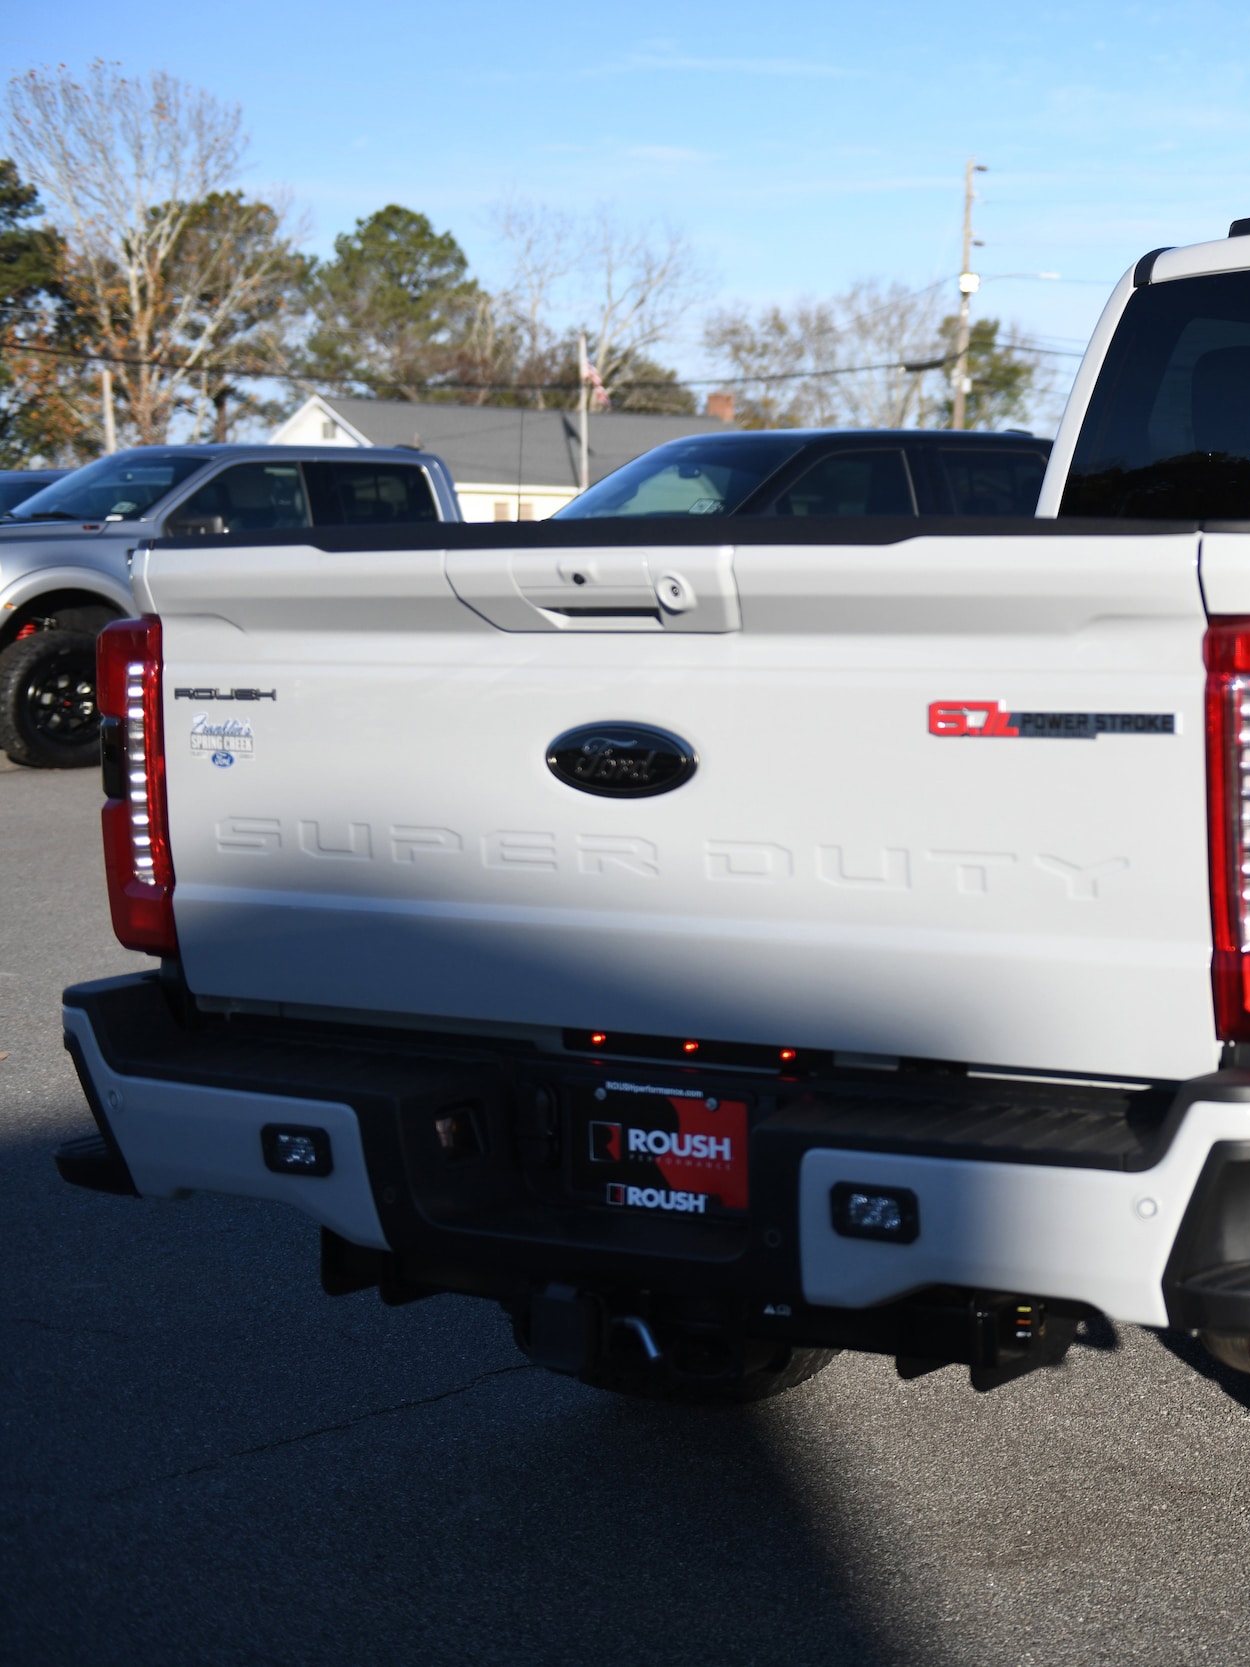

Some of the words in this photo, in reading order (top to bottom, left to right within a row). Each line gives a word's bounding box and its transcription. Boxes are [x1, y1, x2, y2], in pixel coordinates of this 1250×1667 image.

[174, 688, 277, 701] ROUSH
[1021, 713, 1089, 730] POWER
[1096, 714, 1174, 732] STROKE
[575, 737, 657, 781] Ford
[215, 815, 660, 877] SUPER
[704, 838, 1131, 900] DUTY
[628, 1128, 732, 1161] ROUSH
[627, 1186, 706, 1213] ROUSH
